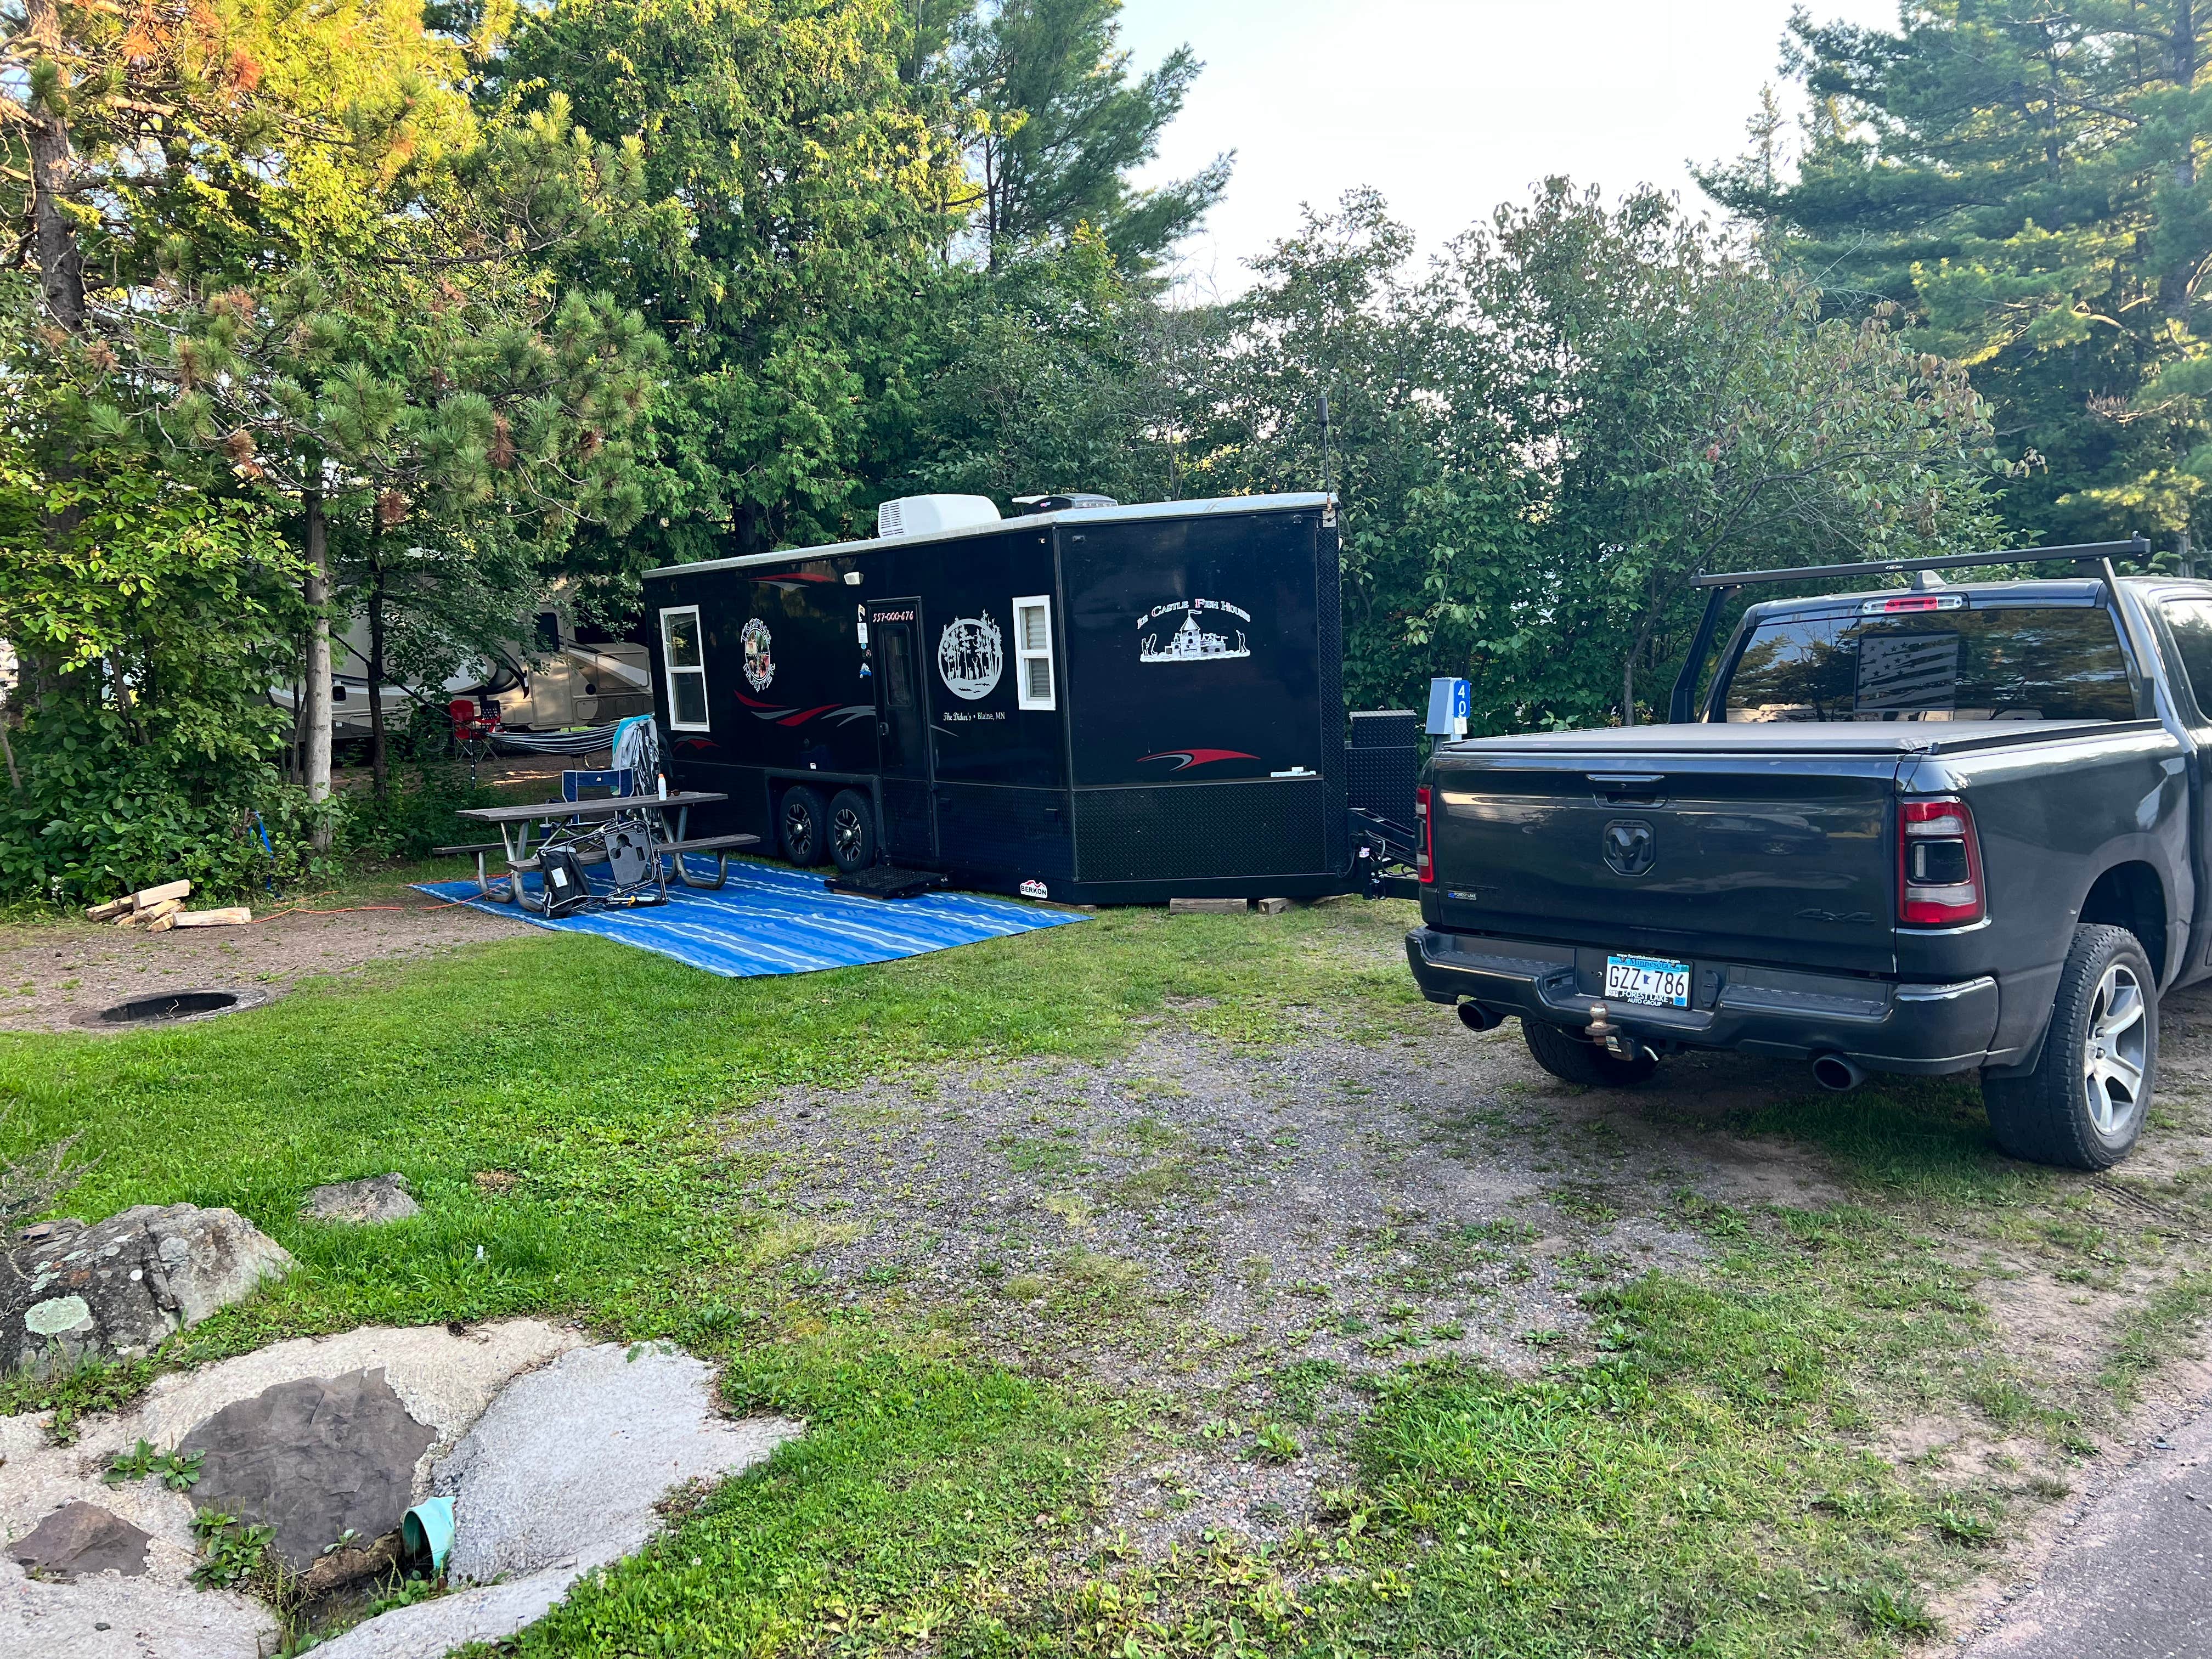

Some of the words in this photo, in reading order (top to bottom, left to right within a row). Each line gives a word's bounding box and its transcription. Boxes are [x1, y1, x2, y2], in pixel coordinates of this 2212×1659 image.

[1152, 601, 1189, 617] CASTLE
[1195, 599, 1219, 610] FISH
[1020, 885, 1046, 895] BERKON
[1610, 966, 1641, 991] GZZ
[1655, 970, 1684, 996] 786
[1622, 990, 1649, 1001] FOREST
[1650, 994, 1668, 1003] LAKE
